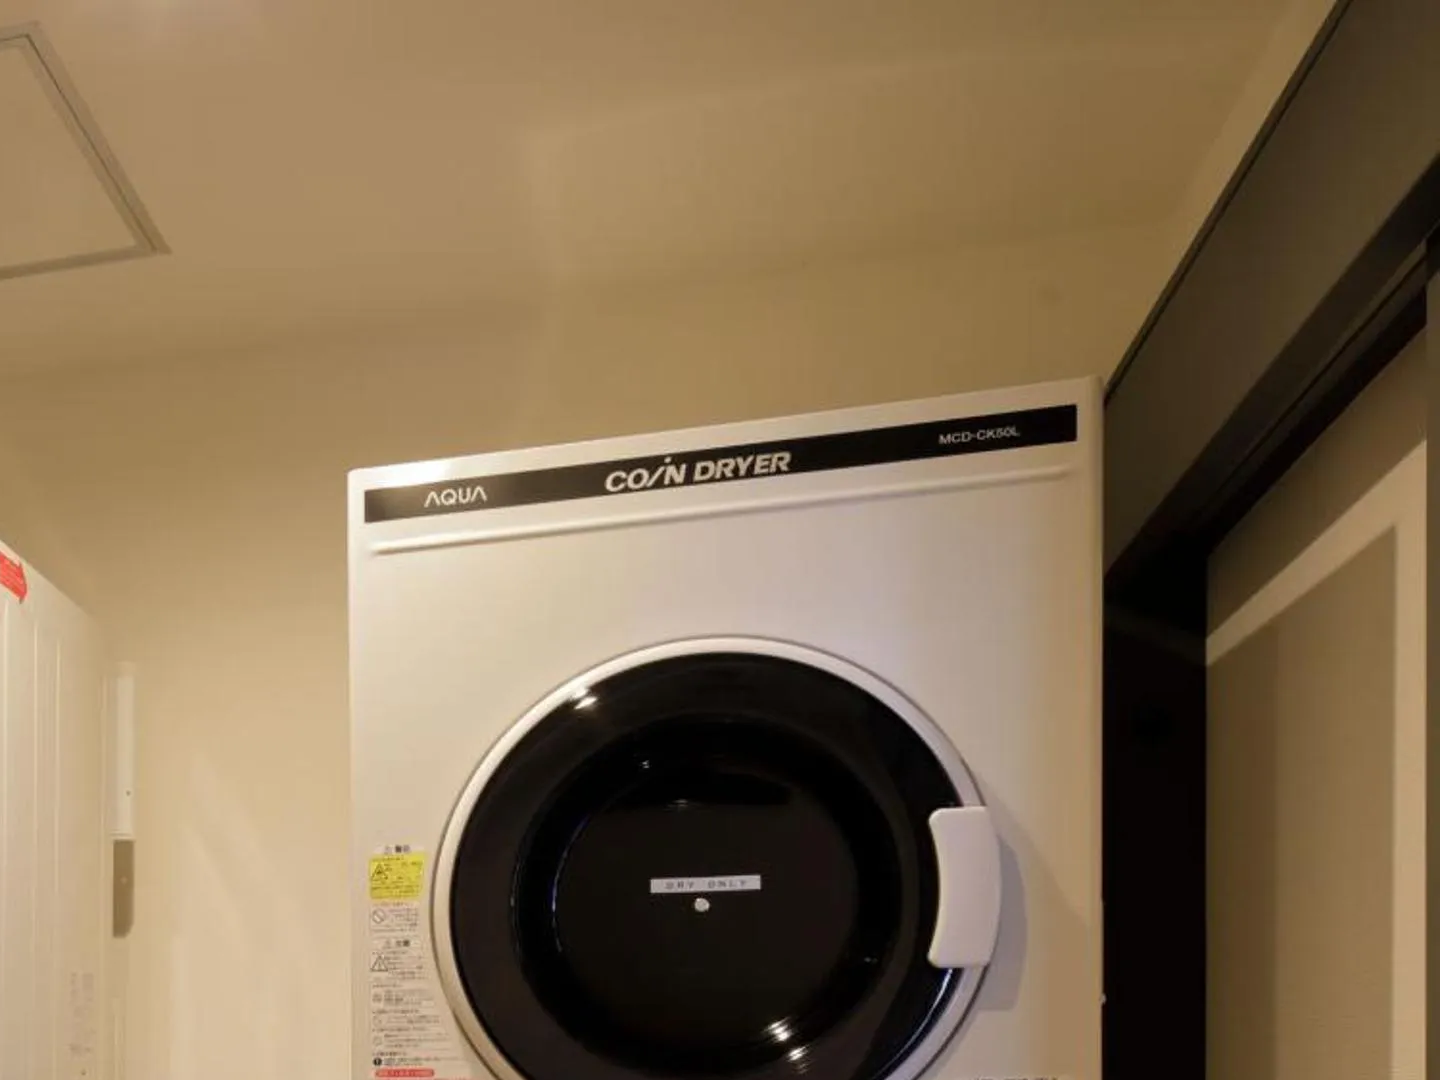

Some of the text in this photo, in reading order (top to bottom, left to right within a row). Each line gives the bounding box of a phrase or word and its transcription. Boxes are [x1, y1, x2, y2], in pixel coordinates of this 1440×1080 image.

[424, 485, 487, 508] AQUA
[605, 457, 686, 492] COIN
[693, 452, 791, 482] DRYER
